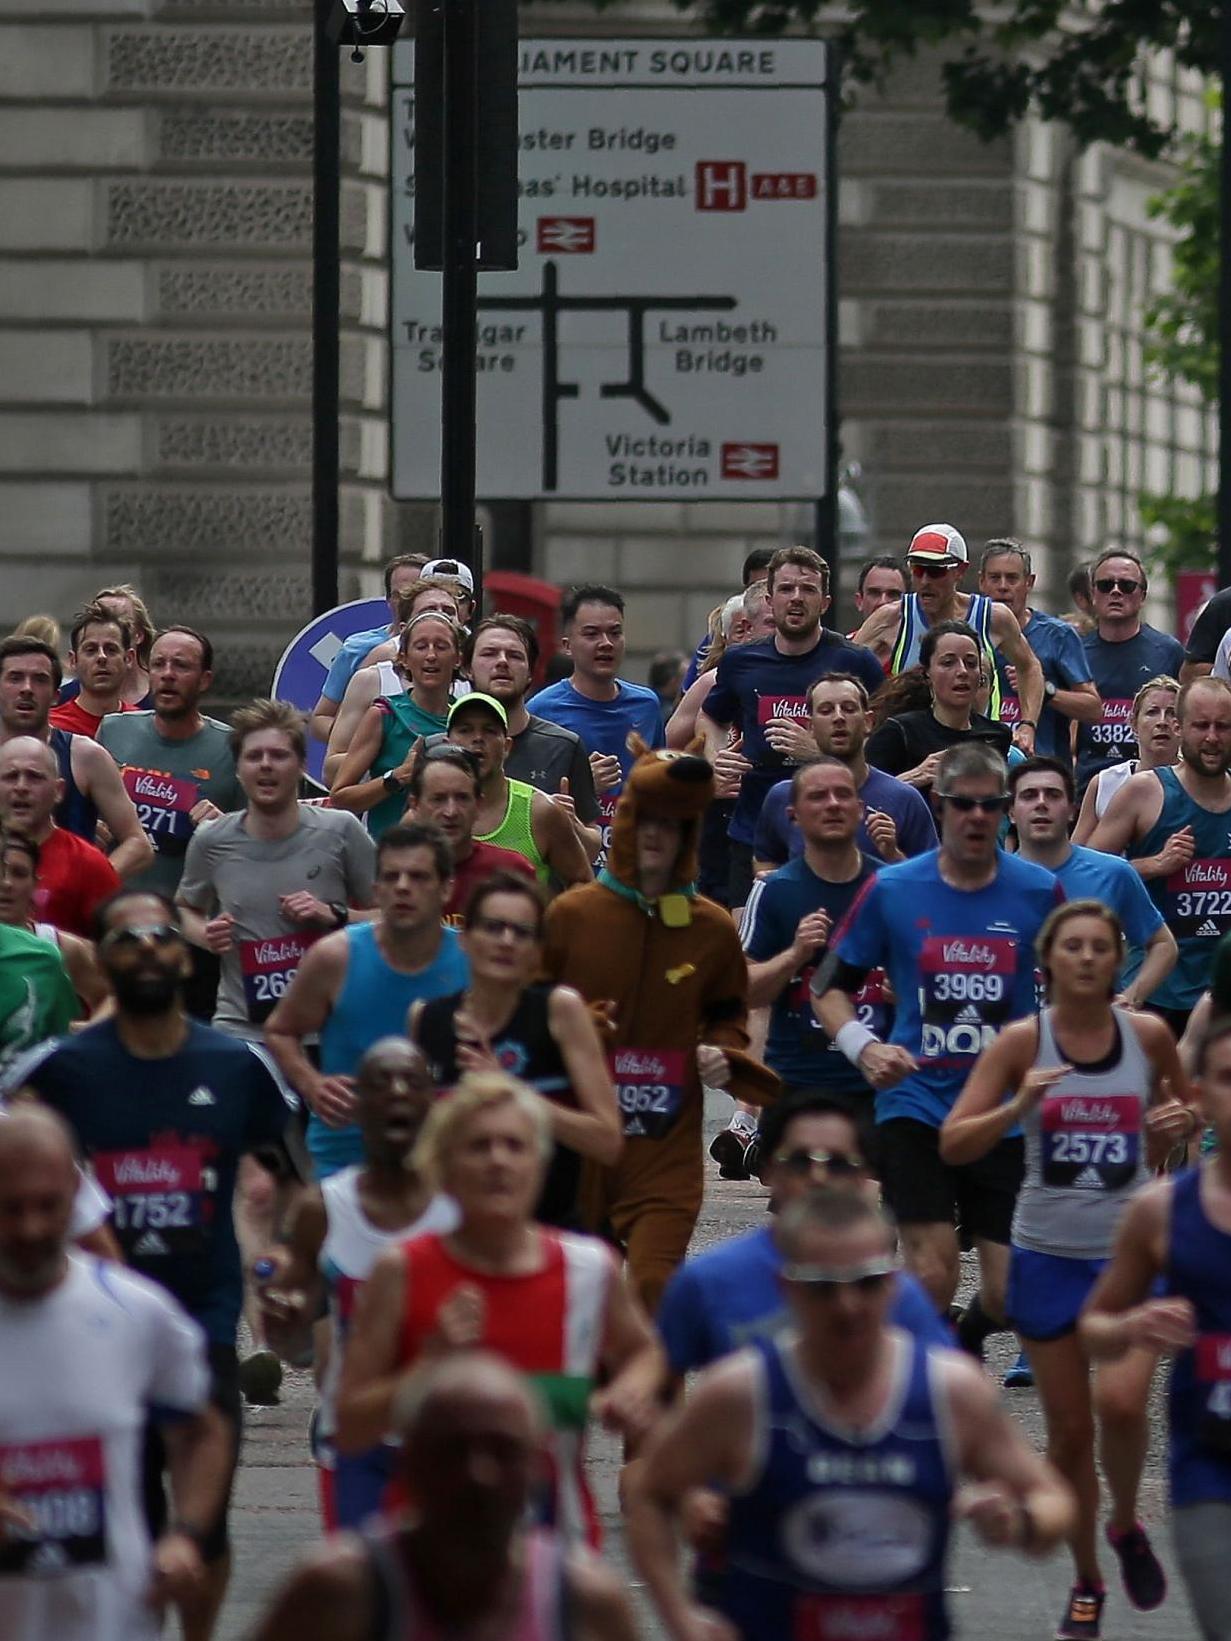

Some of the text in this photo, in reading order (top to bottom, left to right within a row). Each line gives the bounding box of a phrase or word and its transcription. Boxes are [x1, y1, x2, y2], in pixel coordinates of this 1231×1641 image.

[520, 51, 775, 74] IAMENT SQUARE
[588, 127, 677, 154] Bridge
[571, 174, 687, 201] Hospital
[659, 320, 778, 343] Lambeth
[675, 349, 764, 377] Bridge
[605, 433, 711, 458] Victoria
[607, 462, 709, 487] Station
[1091, 724, 1136, 743] 3382
[134, 774, 178, 806] Vitality
[137, 803, 178, 834] 271
[1184, 862, 1228, 888] Vitality
[942, 939, 997, 971] Vitality
[933, 972, 1004, 1002] 3969
[614, 1051, 666, 1080] Vitality
[1060, 1098, 1120, 1131] Vitality
[1051, 1132, 1128, 1164] 2573
[114, 1192, 193, 1230] 1752
